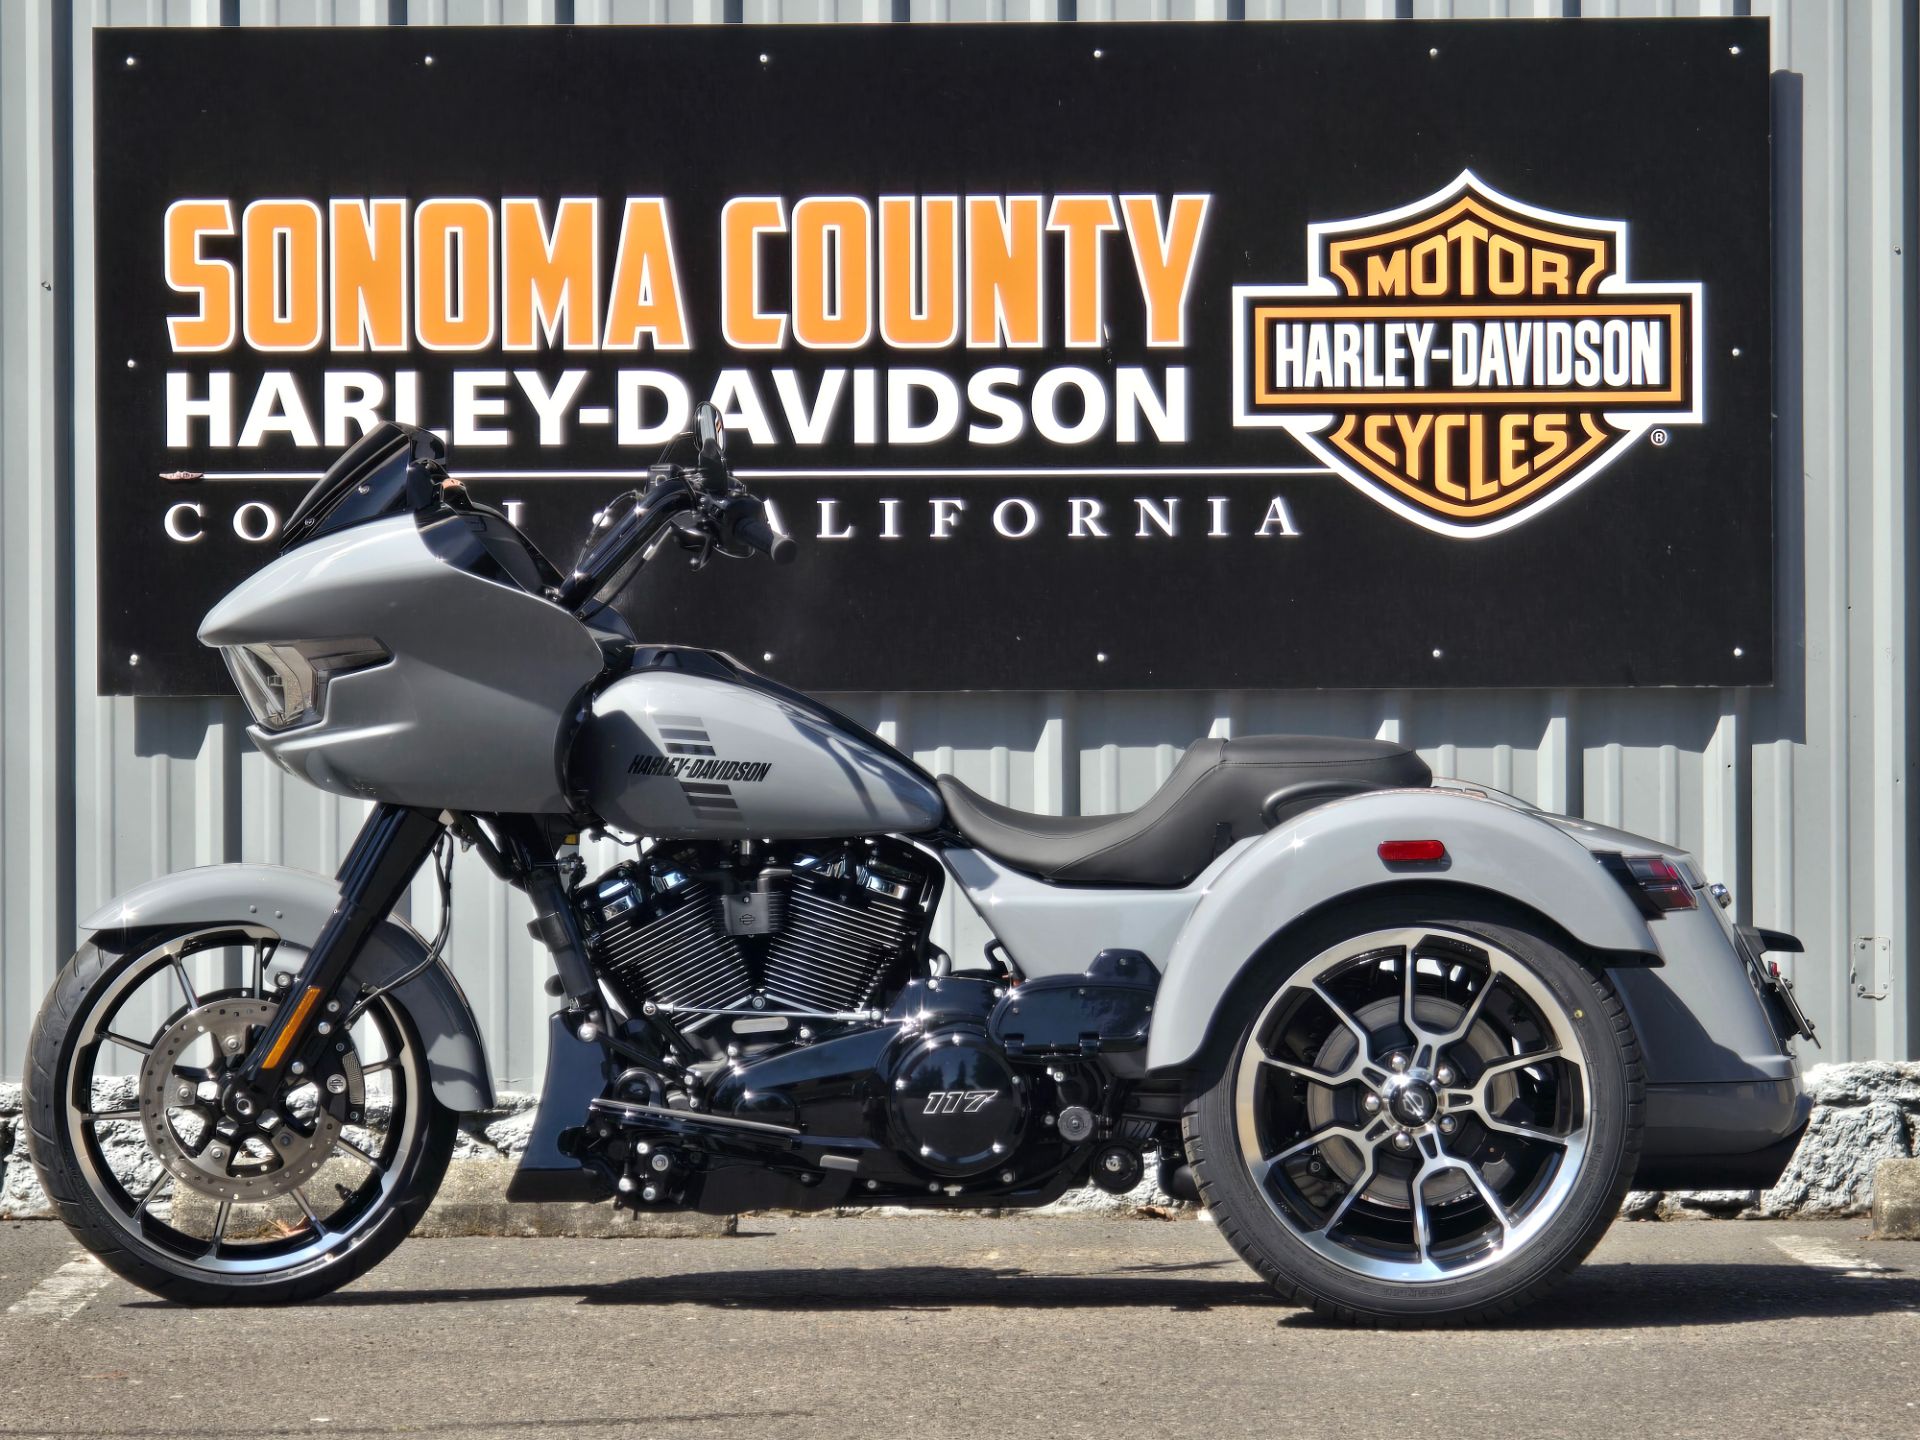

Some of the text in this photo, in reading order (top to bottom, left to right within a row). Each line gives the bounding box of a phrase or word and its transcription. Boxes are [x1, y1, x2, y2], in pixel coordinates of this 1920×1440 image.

[164, 194, 1210, 352] SONOMA COUNTY
[1367, 219, 1569, 296] MOTOR
[1275, 319, 1661, 387] HARLEY-DAVIDSON
[166, 367, 1186, 446] HARLEY-DAVIDSON
[1364, 412, 1569, 501] CYCLES
[763, 498, 1301, 539] LIFORNIA
[628, 755, 772, 782] HARLEY-DAVIDSON
[922, 1090, 998, 1114] 117
